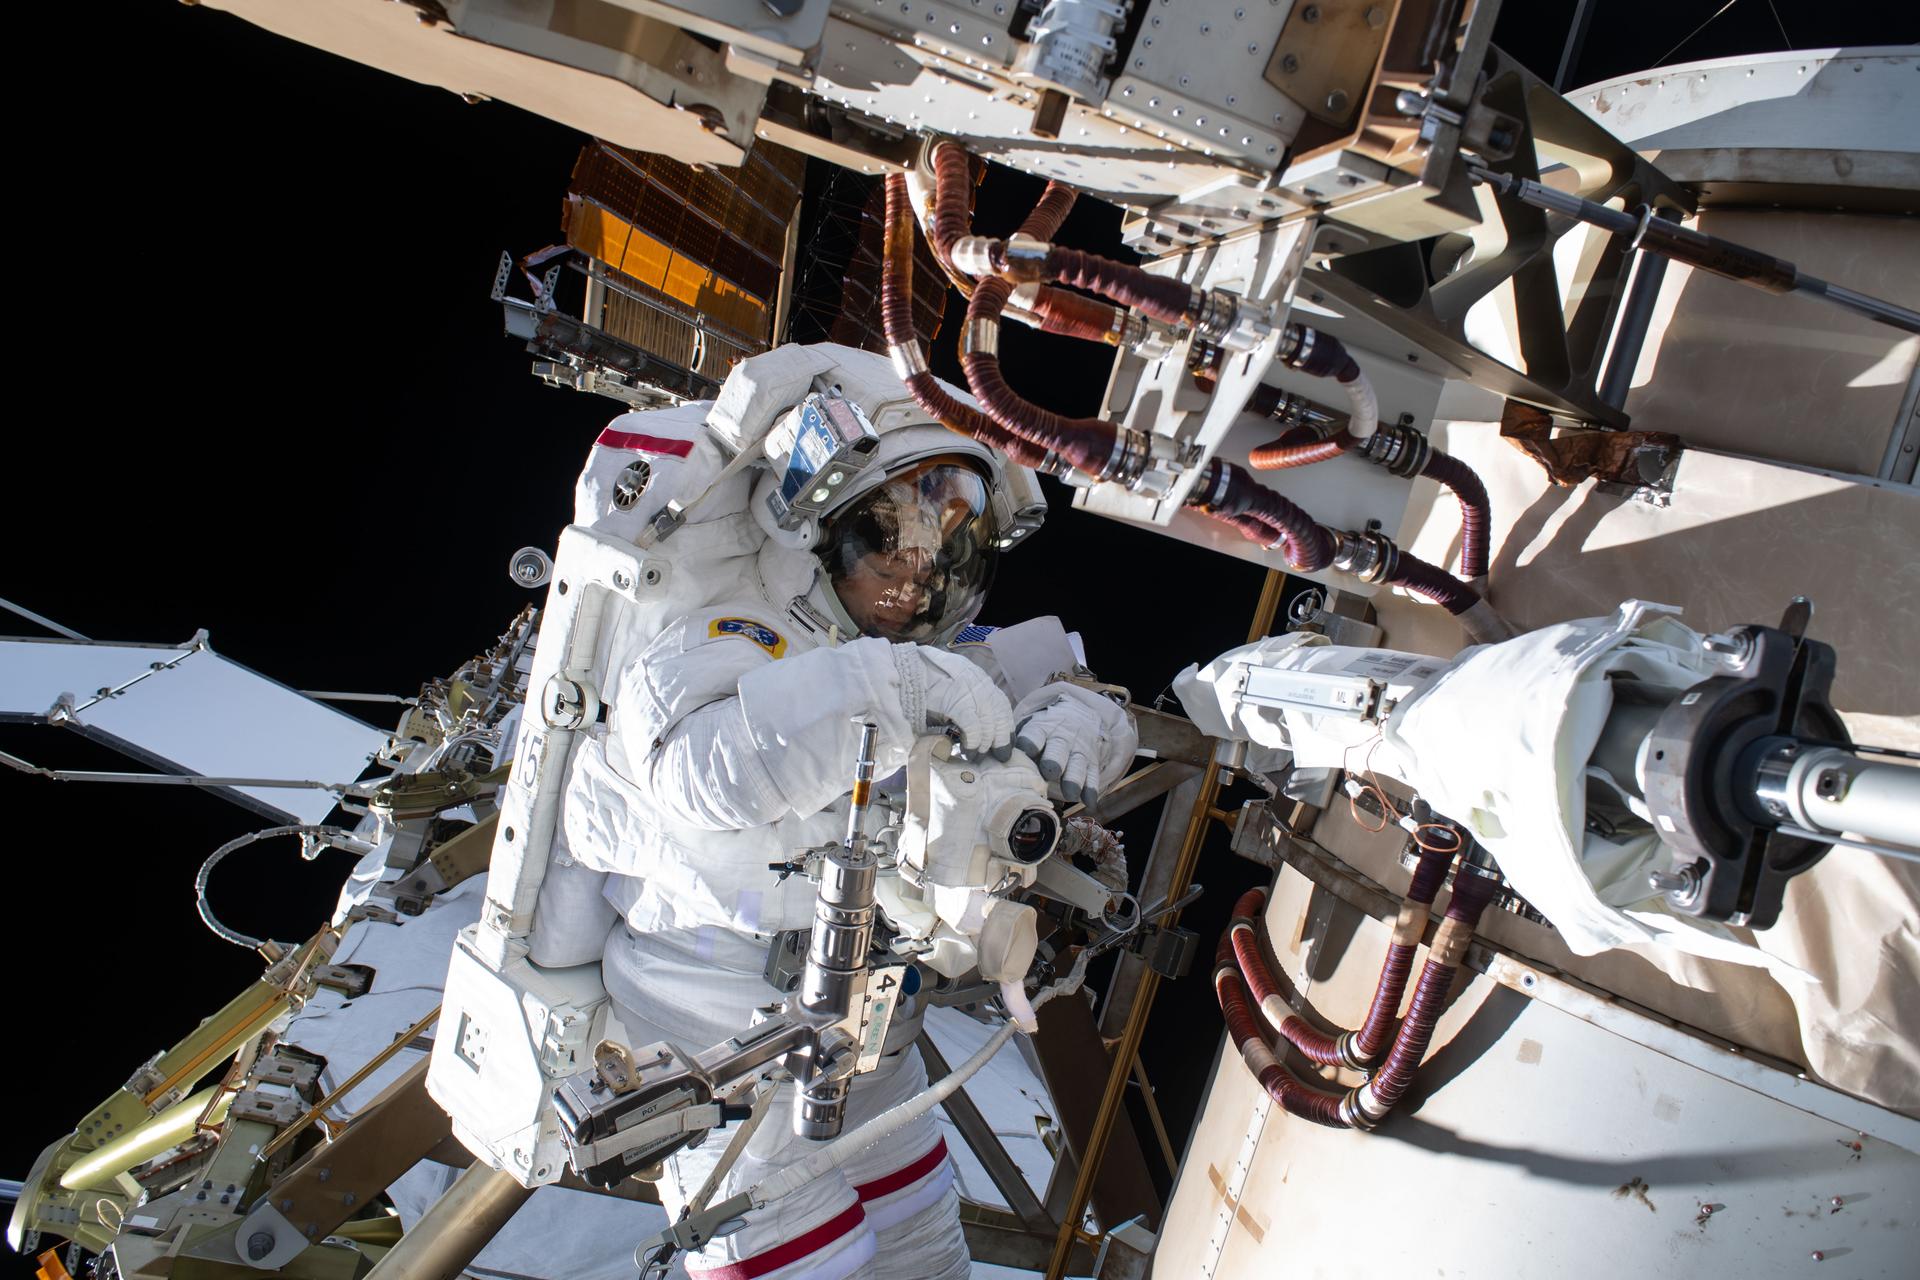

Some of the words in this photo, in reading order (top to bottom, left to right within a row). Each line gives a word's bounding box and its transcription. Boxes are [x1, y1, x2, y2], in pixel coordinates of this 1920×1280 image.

[517, 729, 543, 788] 15
[877, 974, 896, 992] 4
[642, 1104, 658, 1116] PGT
